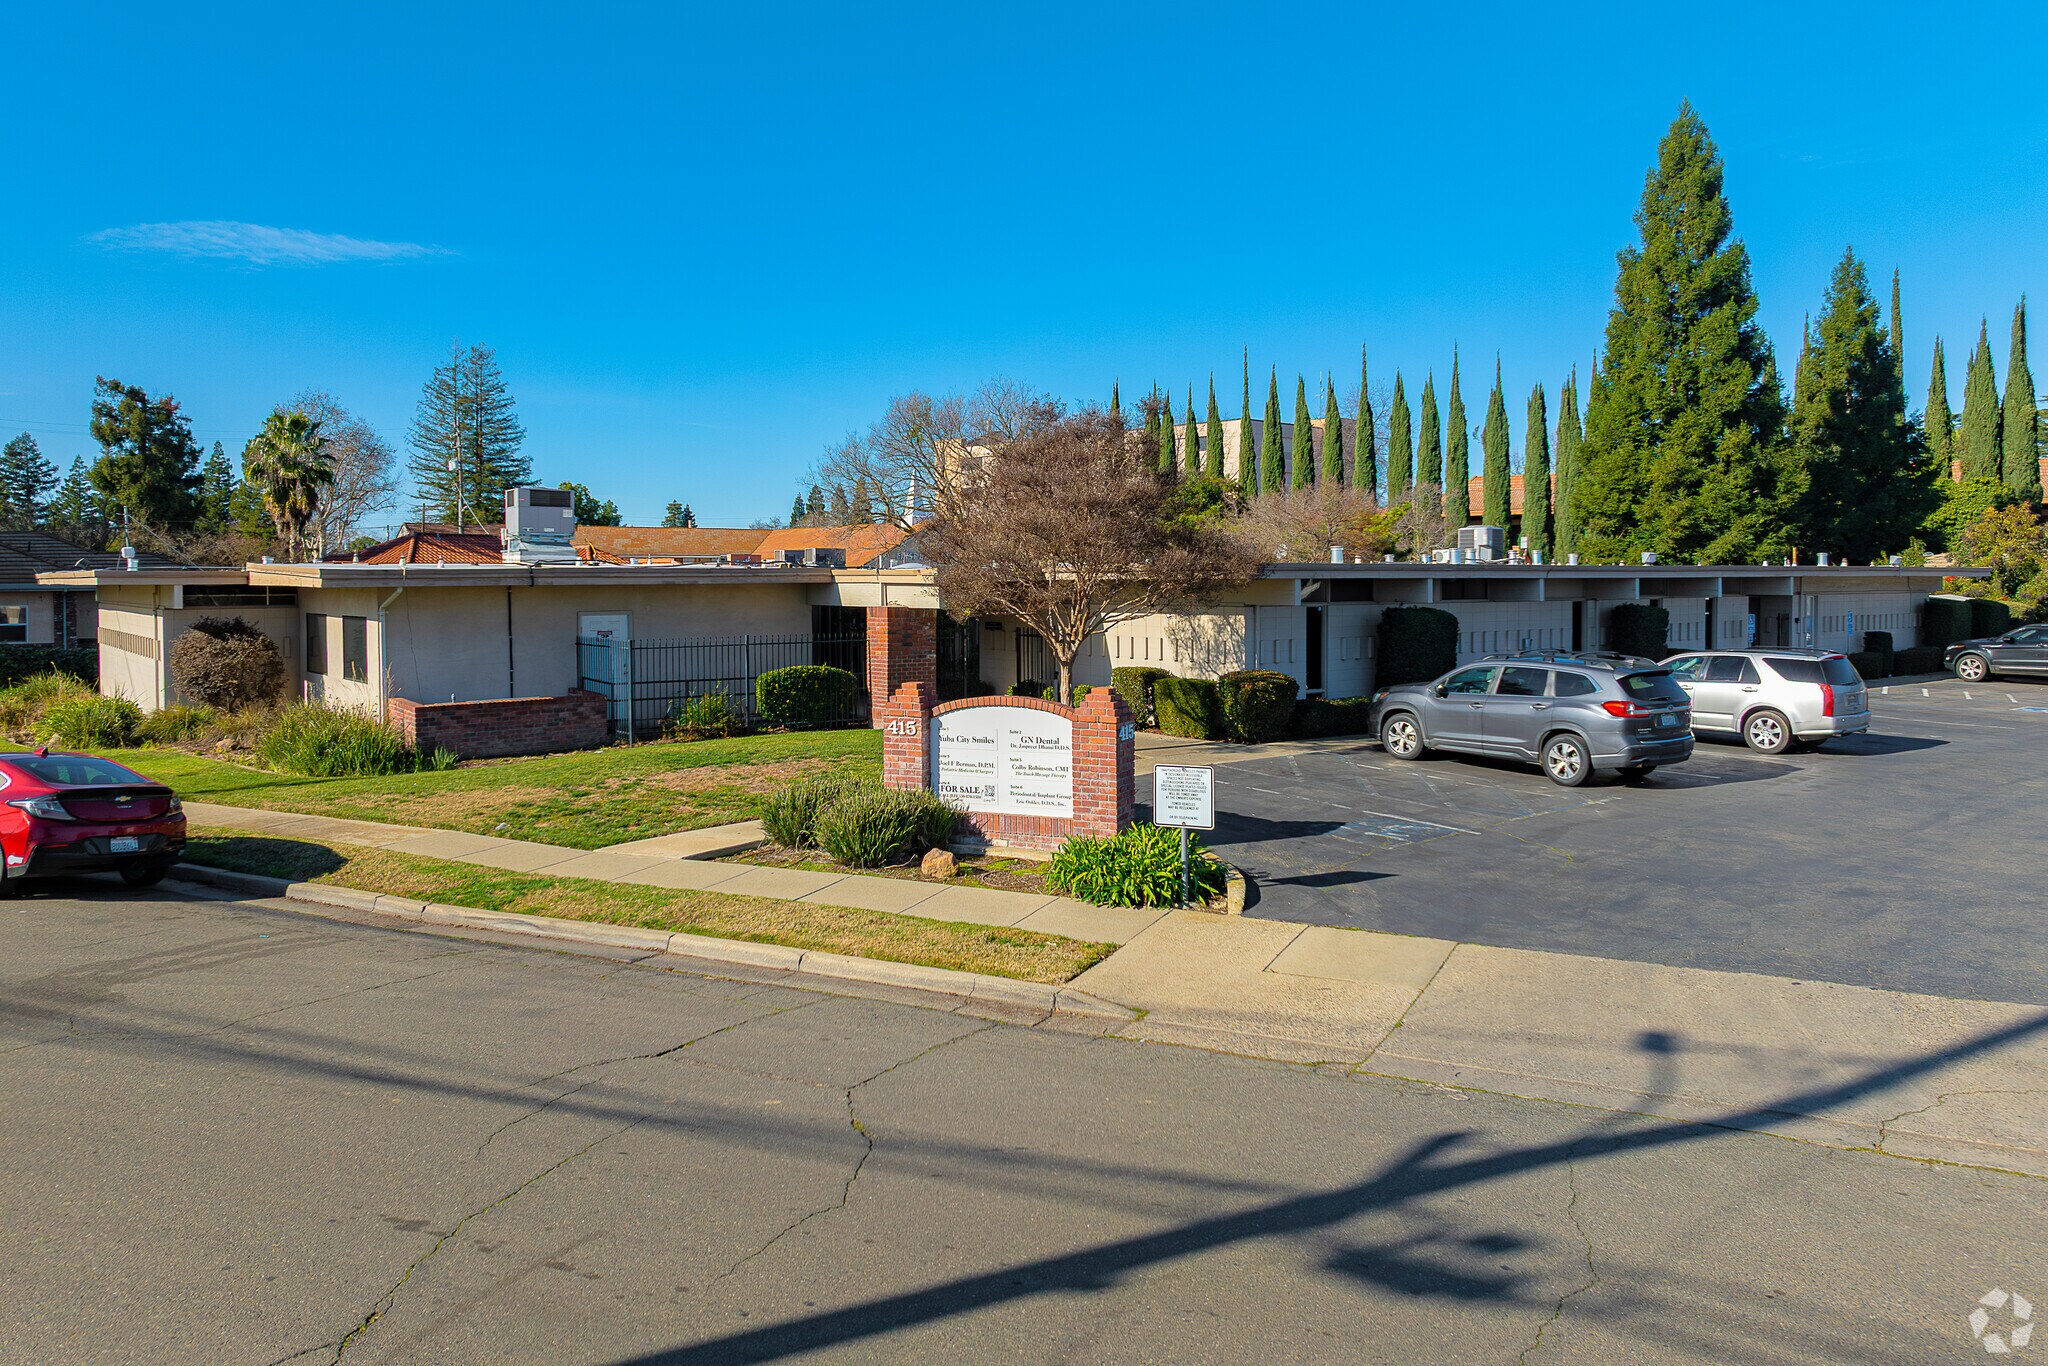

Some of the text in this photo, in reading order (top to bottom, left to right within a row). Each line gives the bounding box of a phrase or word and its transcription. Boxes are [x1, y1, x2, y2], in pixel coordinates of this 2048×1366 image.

[887, 720, 917, 735] 415
[1119, 724, 1134, 740] 415
[938, 734, 995, 744] Yuba City Smiles
[1020, 736, 1060, 745] GN Dental
[940, 785, 980, 794] FOR SALE
